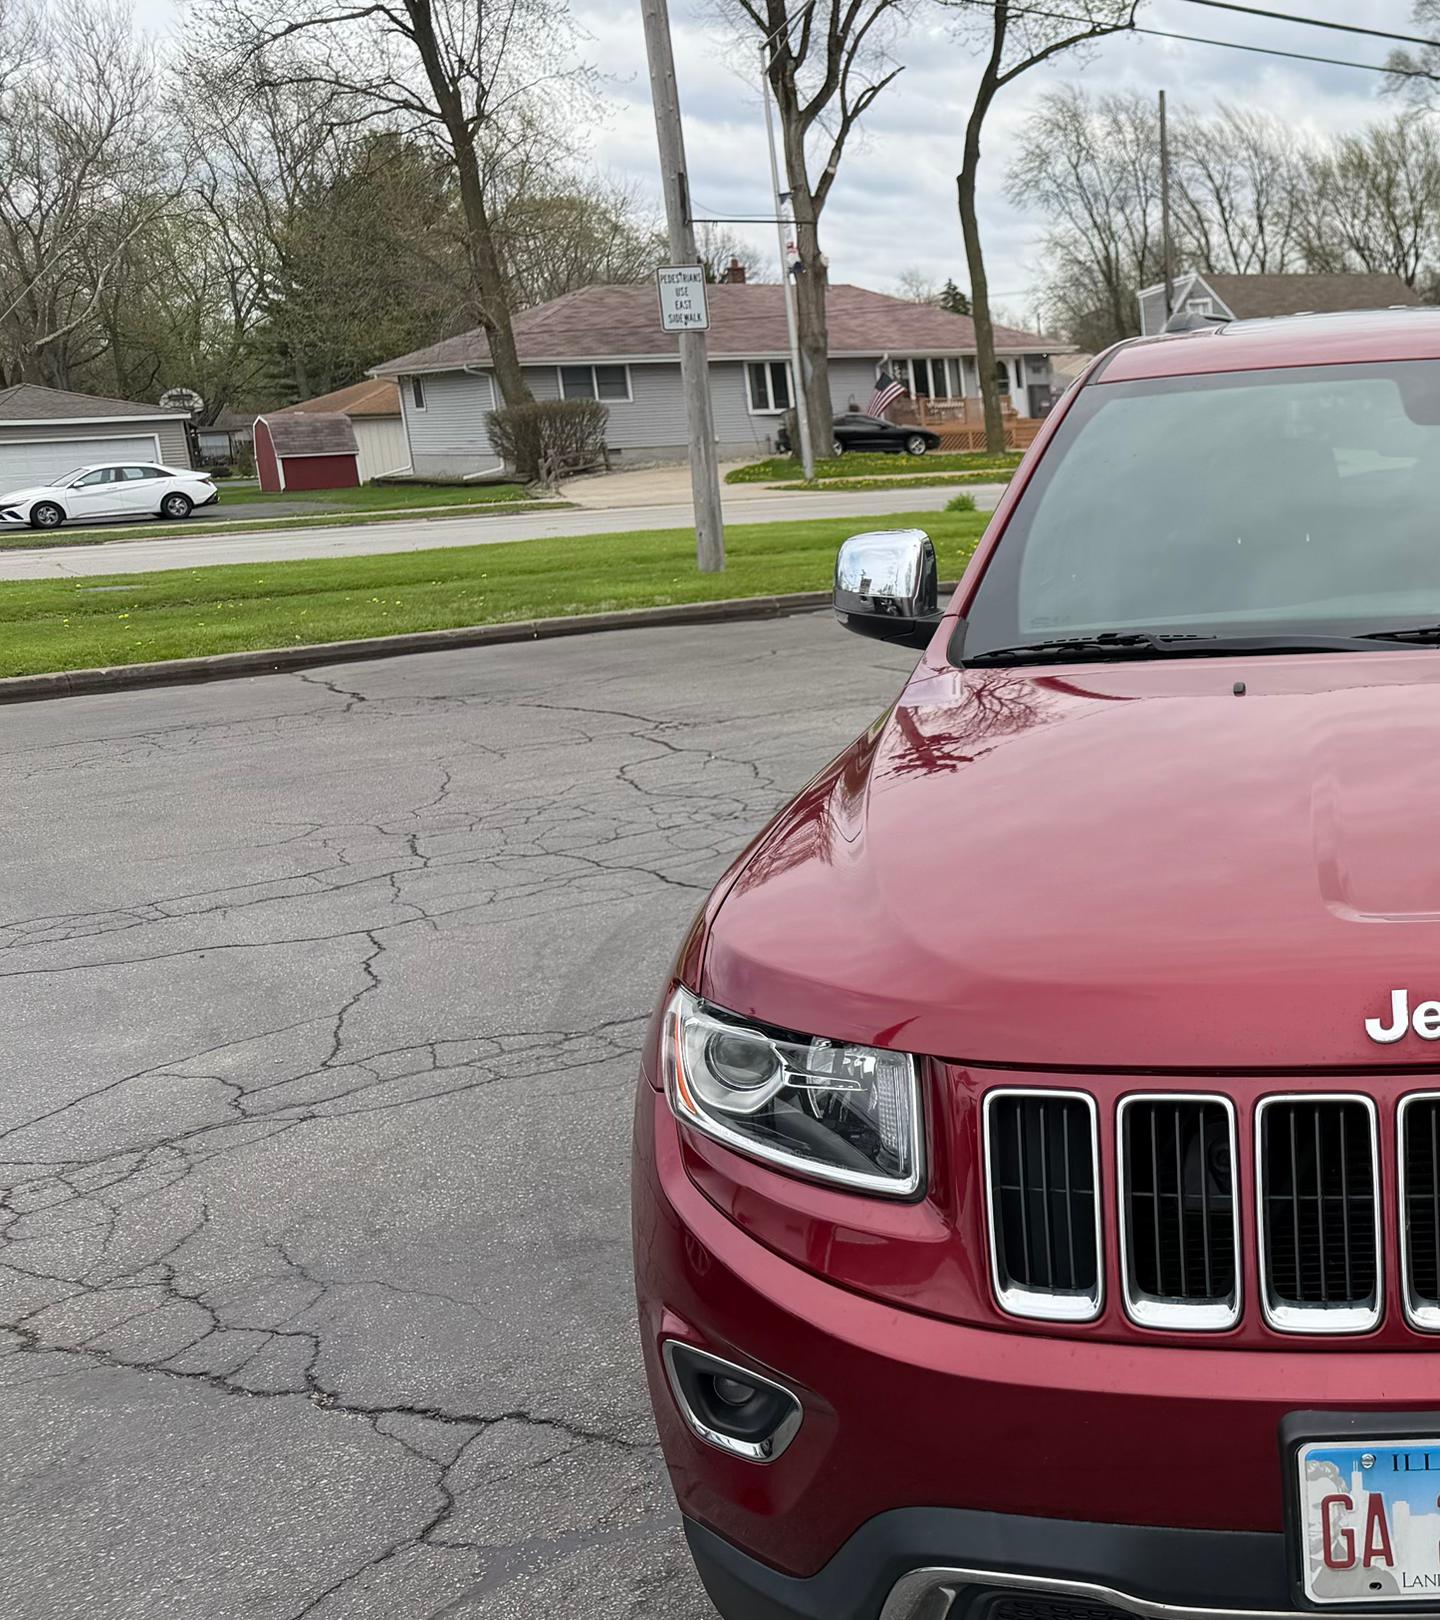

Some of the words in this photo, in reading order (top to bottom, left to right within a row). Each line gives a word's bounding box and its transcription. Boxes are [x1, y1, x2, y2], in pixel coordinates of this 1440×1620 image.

[660, 272, 702, 283] PEDESTRIANS
[675, 287, 689, 297] USE
[675, 300, 692, 310] EAST
[668, 313, 703, 323] SIDEWALK
[1320, 1492, 1395, 1570] GA
